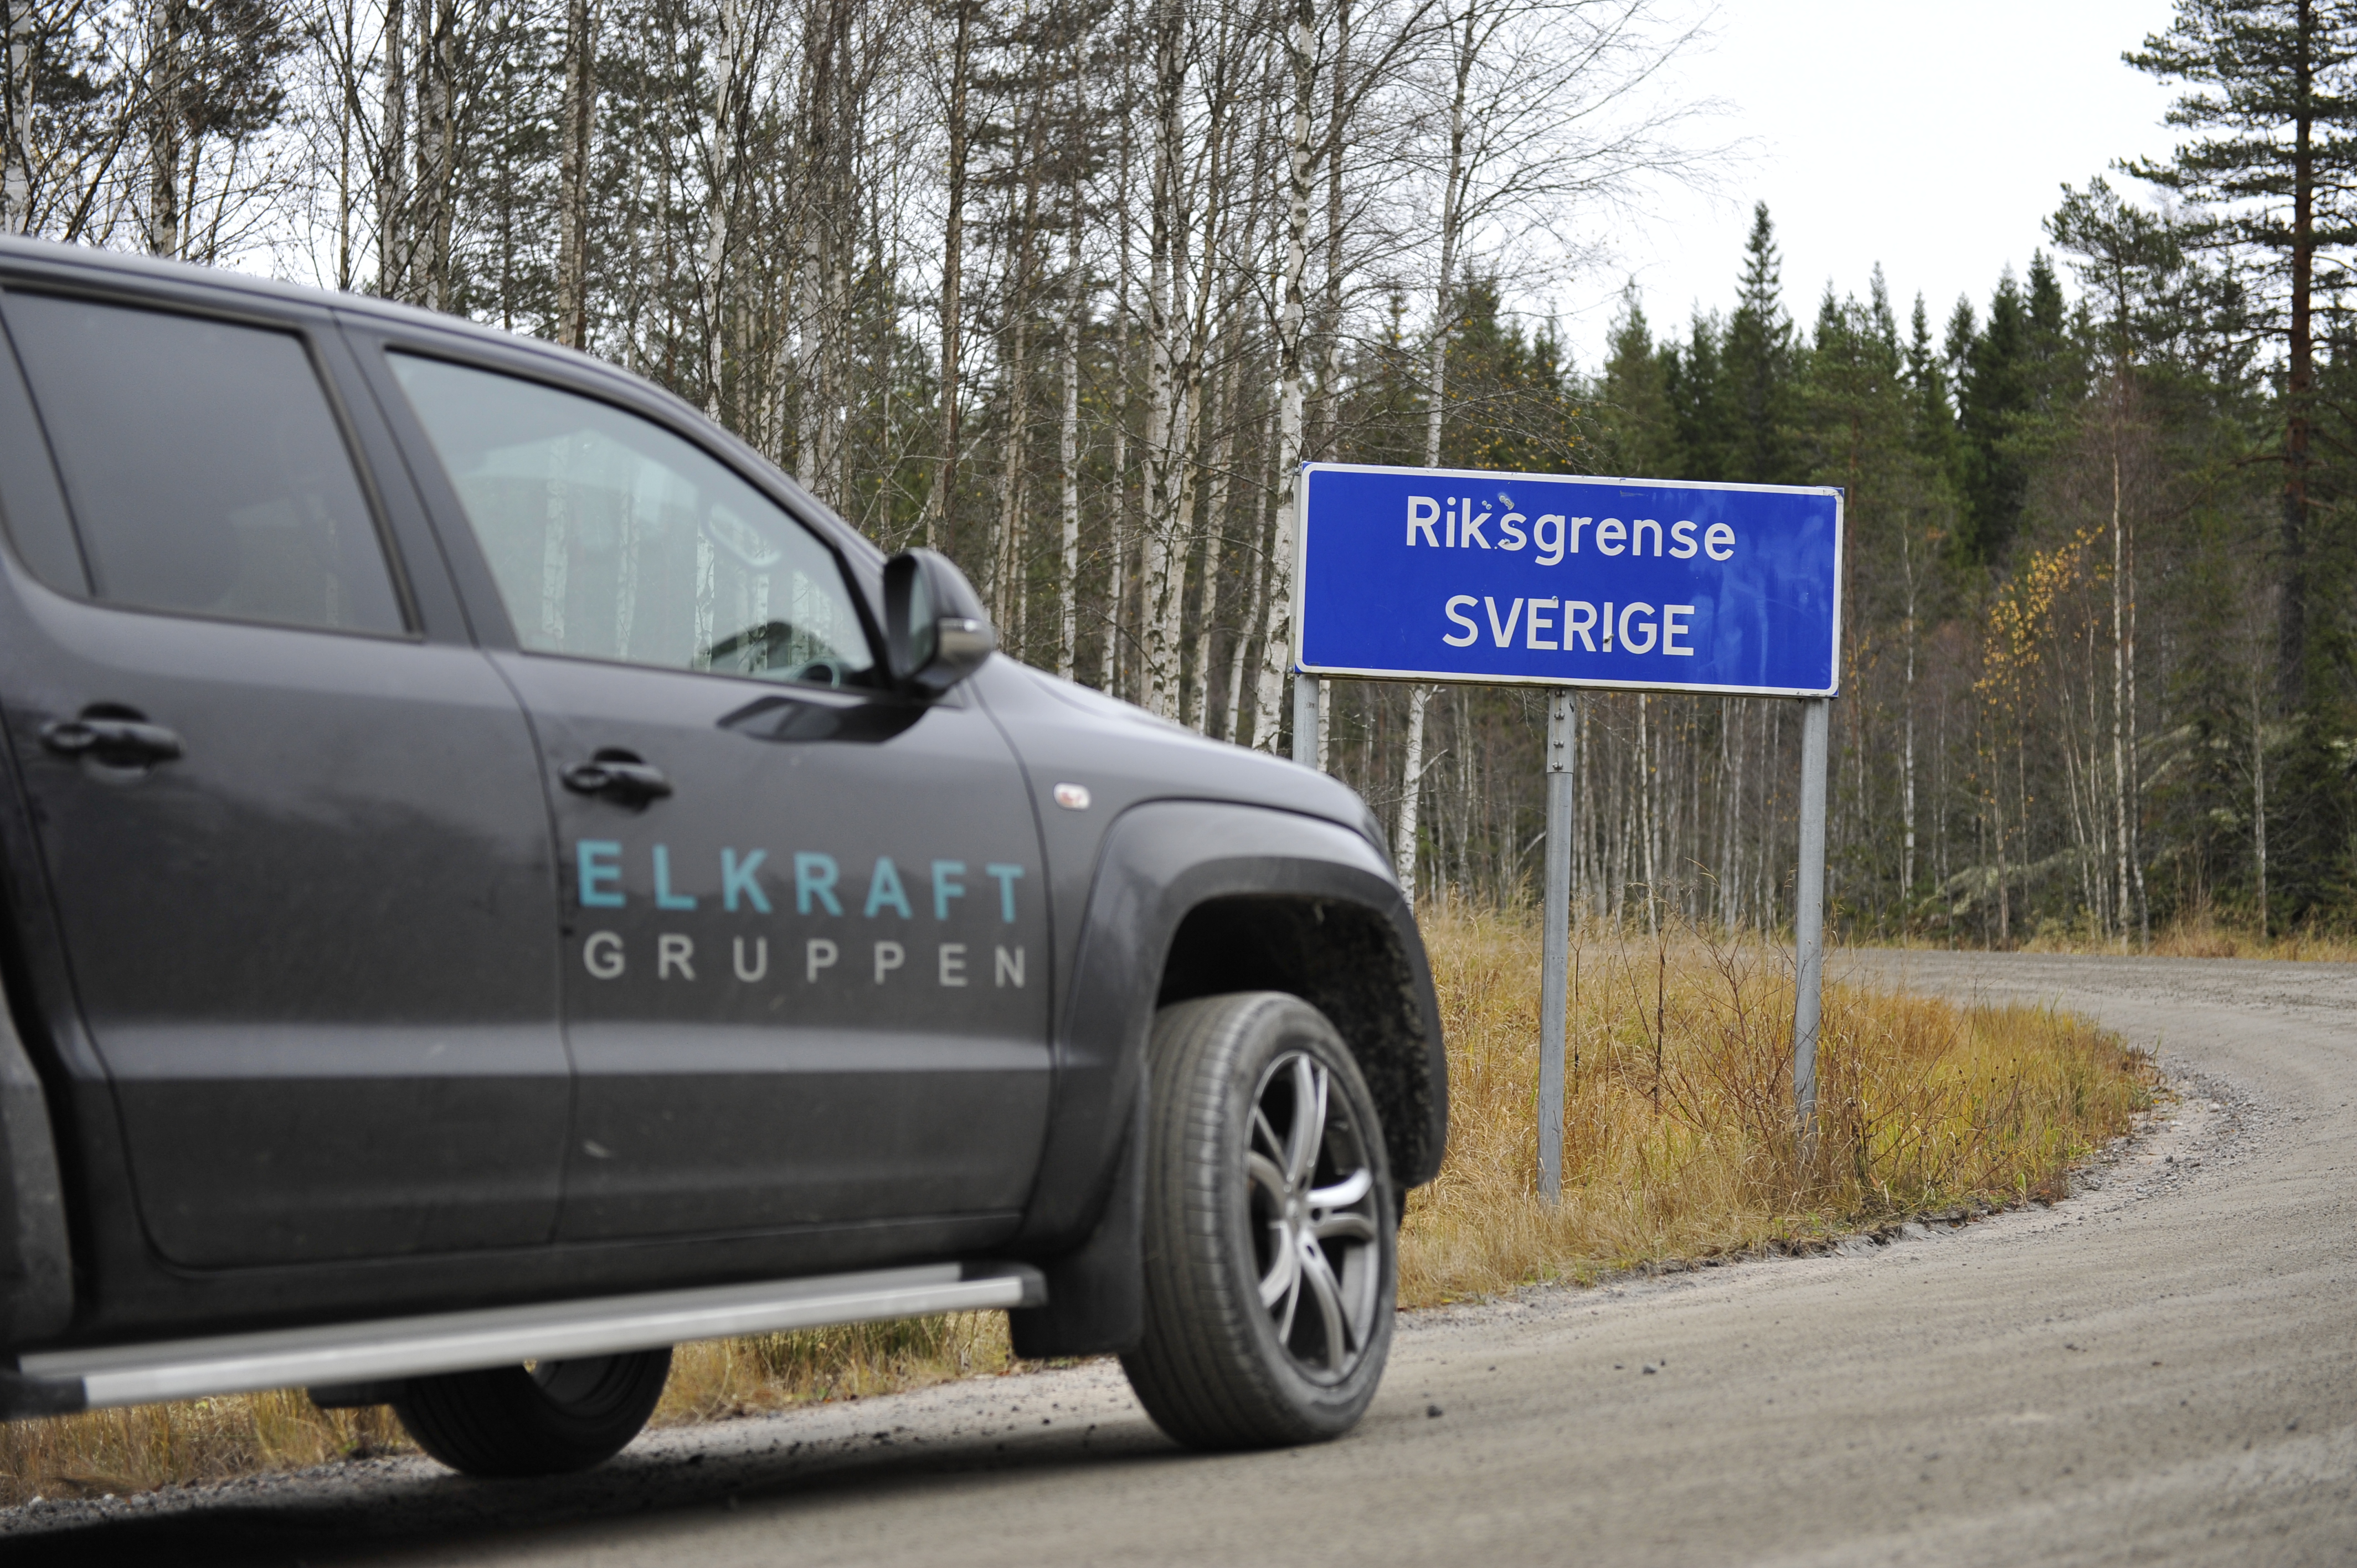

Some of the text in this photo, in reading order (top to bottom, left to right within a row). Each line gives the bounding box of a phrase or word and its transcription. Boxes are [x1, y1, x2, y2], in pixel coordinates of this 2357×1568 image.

[1407, 496, 1736, 566] Riksgrense
[1442, 595, 1695, 656] SVERIGE
[577, 839, 1025, 923] ELKRAFT
[583, 931, 1025, 988] GRUPPEN
